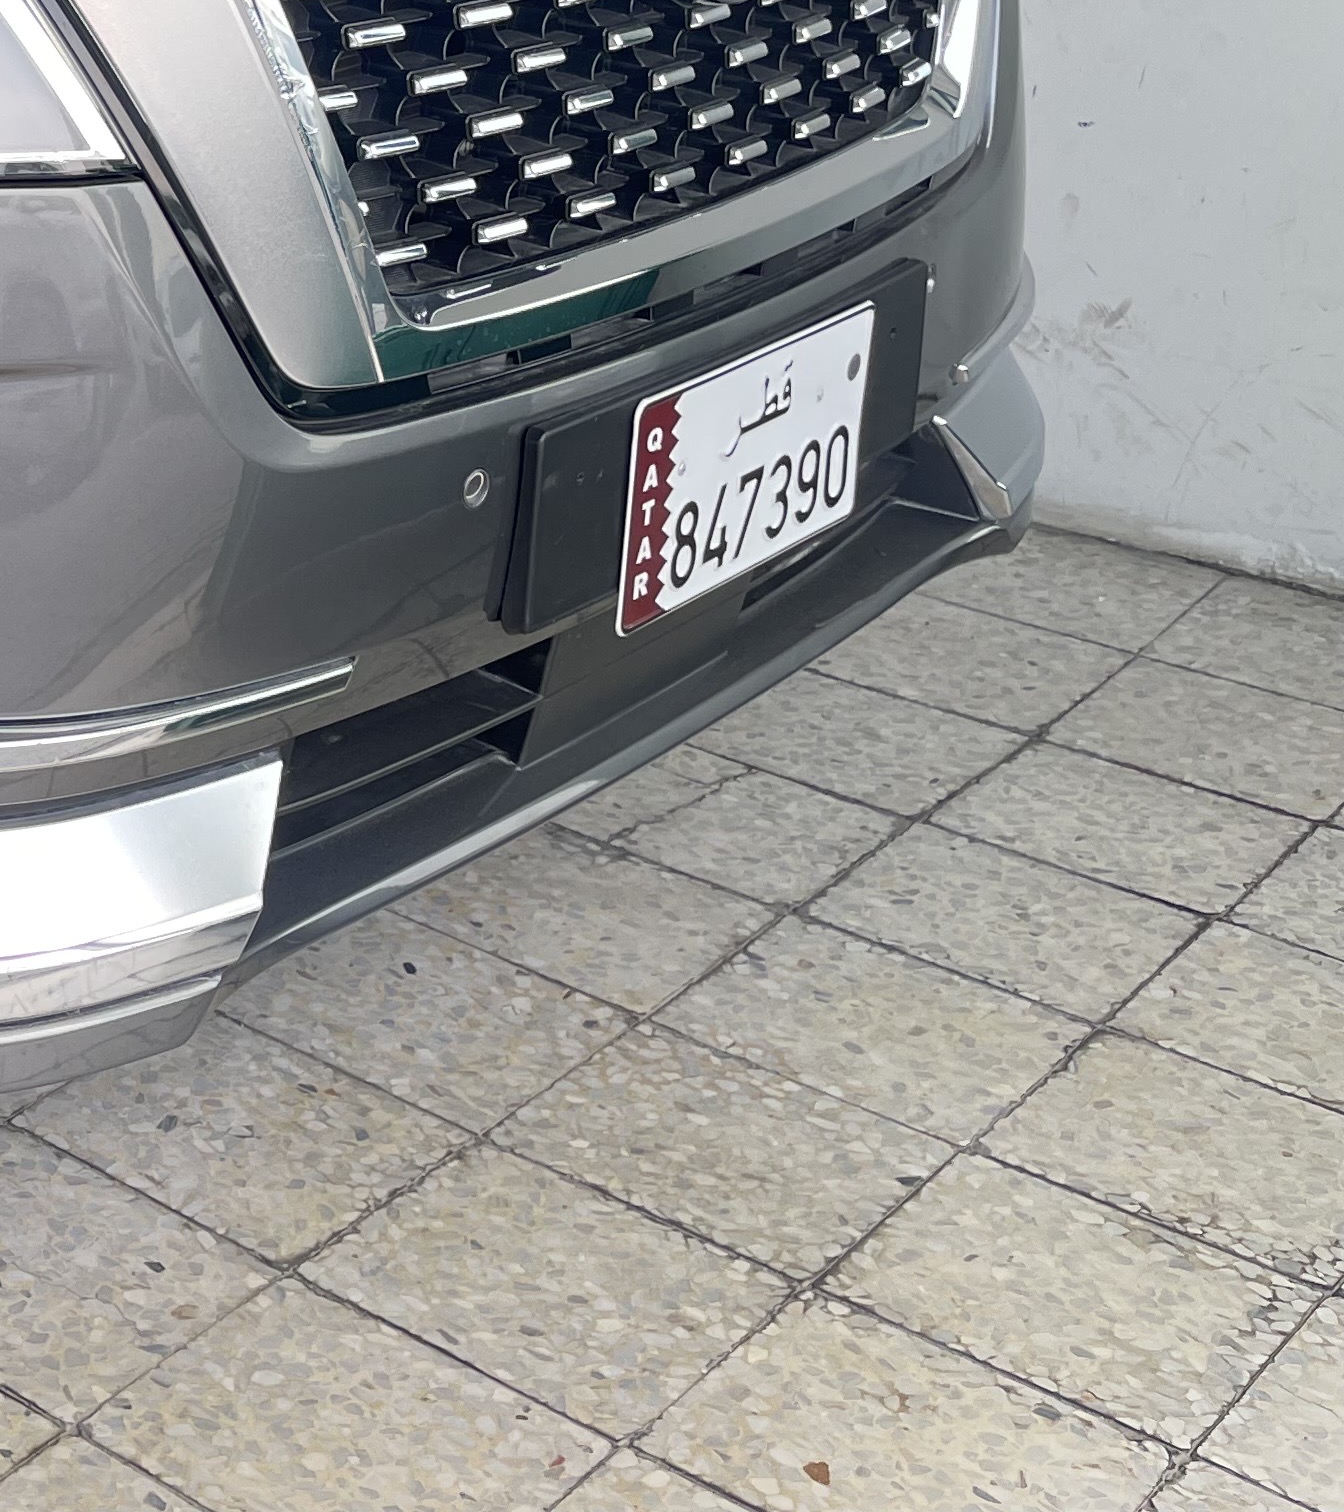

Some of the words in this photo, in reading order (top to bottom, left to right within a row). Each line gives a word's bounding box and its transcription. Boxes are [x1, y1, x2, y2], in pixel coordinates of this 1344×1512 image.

[724, 359, 794, 458] قطر
[632, 427, 663, 600] QATAR
[669, 424, 851, 589] 847390
